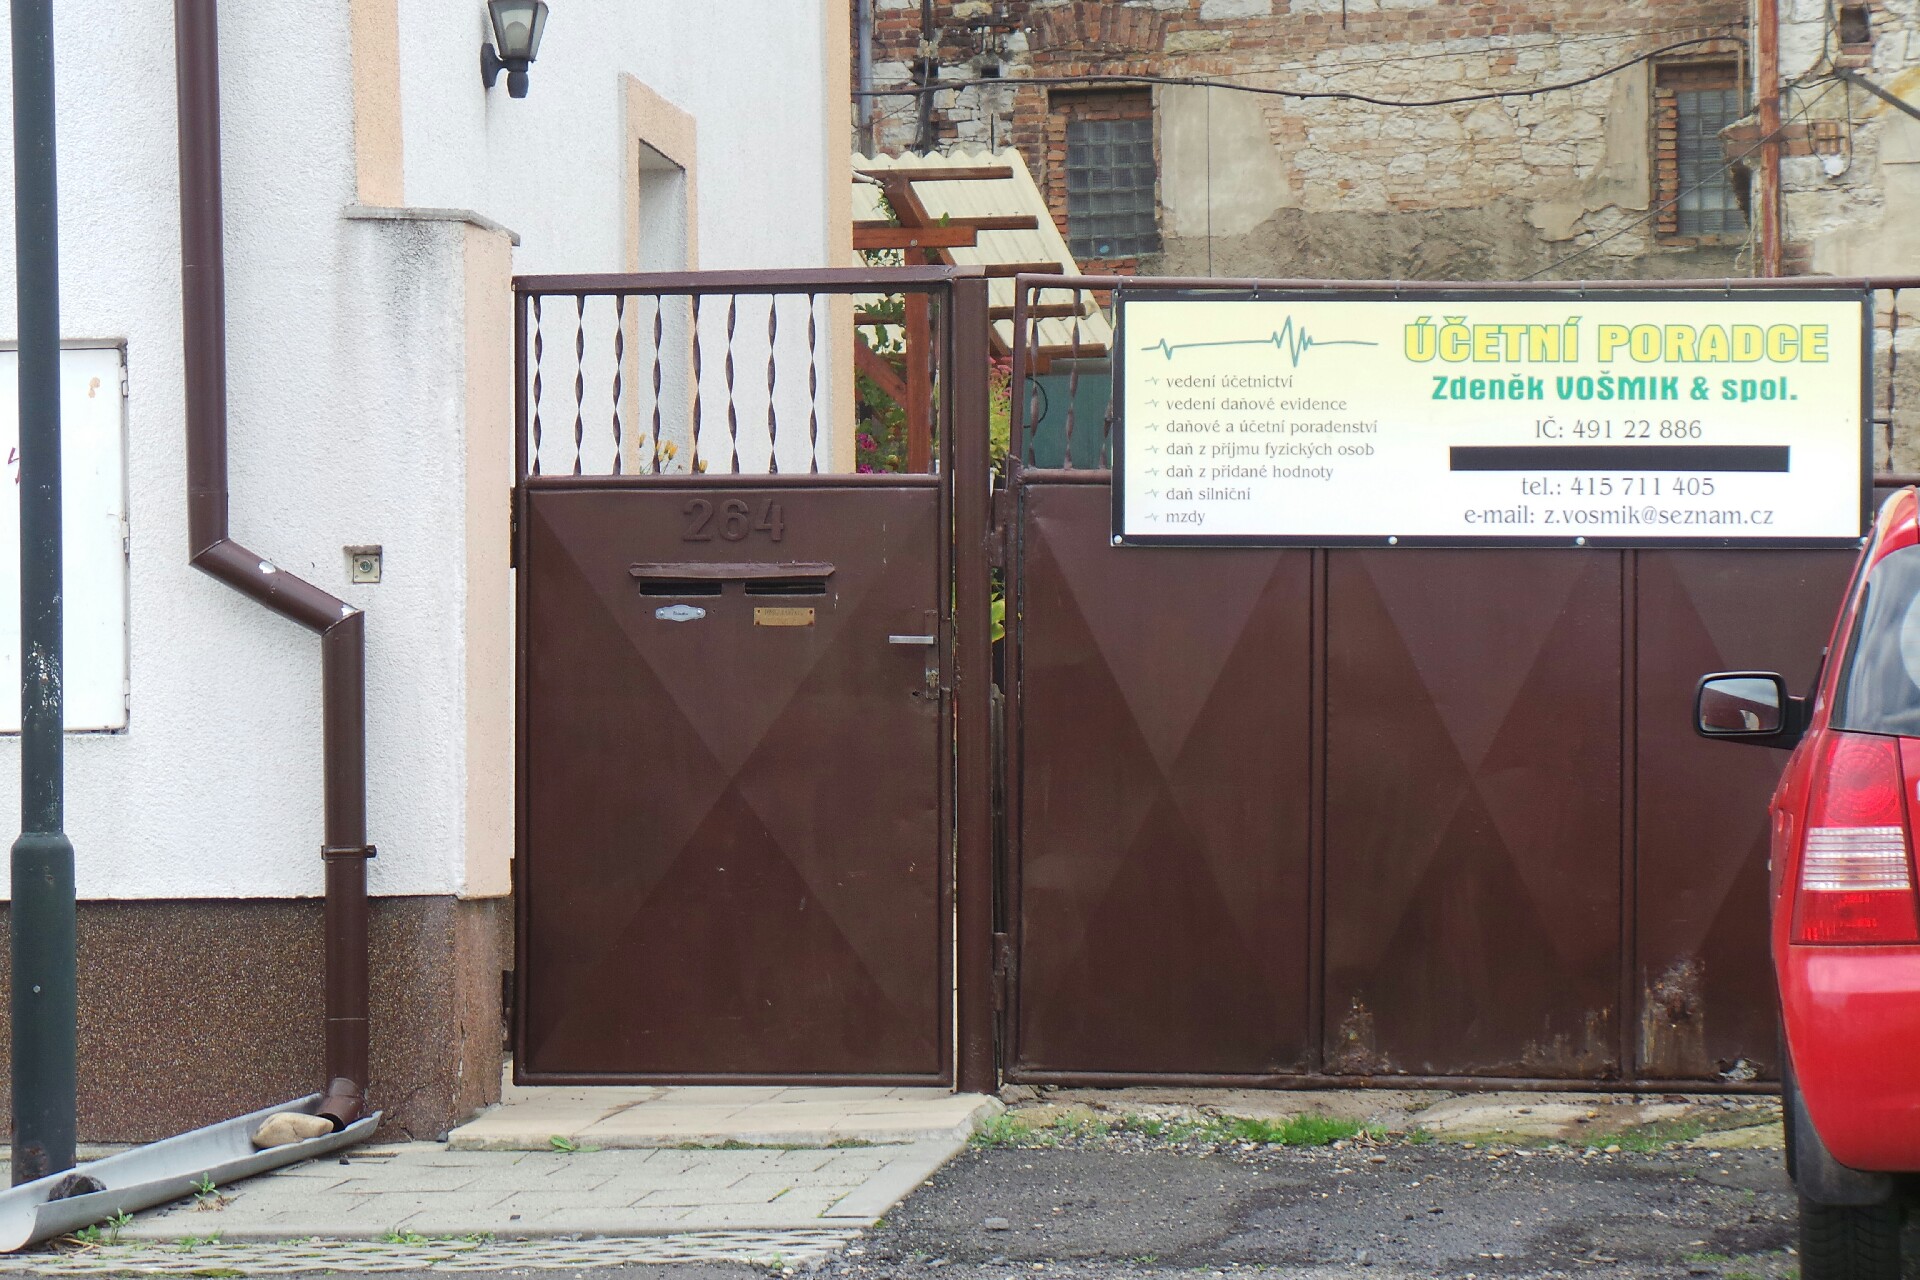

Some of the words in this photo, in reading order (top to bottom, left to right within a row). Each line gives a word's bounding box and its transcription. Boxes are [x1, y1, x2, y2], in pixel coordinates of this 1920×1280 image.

[1404, 315, 1582, 363] ÚČETNÍ
[1597, 324, 1829, 363] PORADCE
[1166, 374, 1216, 388] vedení
[1221, 374, 1293, 388] účetnictví
[1431, 373, 1544, 401] Zdeněk
[1556, 370, 1679, 401] VOŠMIK
[1690, 376, 1710, 401] &
[1721, 376, 1798, 404] spol.
[1166, 397, 1216, 411] vedení
[1221, 397, 1275, 411] daňové
[1280, 397, 1347, 411] evidence
[1166, 420, 1220, 433] daňové
[1225, 423, 1234, 433] a
[1239, 420, 1285, 433] účetní
[1290, 420, 1378, 436] poradenství
[1536, 415, 1563, 439] IČ:
[1572, 419, 1612, 439] 491
[1624, 419, 1650, 439] 22
[1659, 419, 1702, 439] 886
[1166, 442, 1193, 456] daň
[1199, 446, 1206, 456] z
[1211, 442, 1260, 459] příjmu
[1265, 442, 1333, 459] fyzických
[1338, 442, 1375, 456] osob
[1166, 465, 1193, 478] daň
[1199, 468, 1206, 478] z
[1211, 465, 1268, 481] přidané
[1273, 465, 1334, 481] hodnoty
[1166, 487, 1193, 500] daň
[1198, 487, 1251, 500] silniční
[1522, 477, 1562, 496] tel.:
[1570, 477, 1613, 496] 415
[1622, 477, 1661, 496] 711
[1672, 477, 1715, 496] 405
[683, 499, 784, 542] 264
[1166, 510, 1206, 525] mzdy
[1464, 504, 1534, 525] e-mail:
[1544, 504, 1774, 525] z.vosmik@seznam.cz
